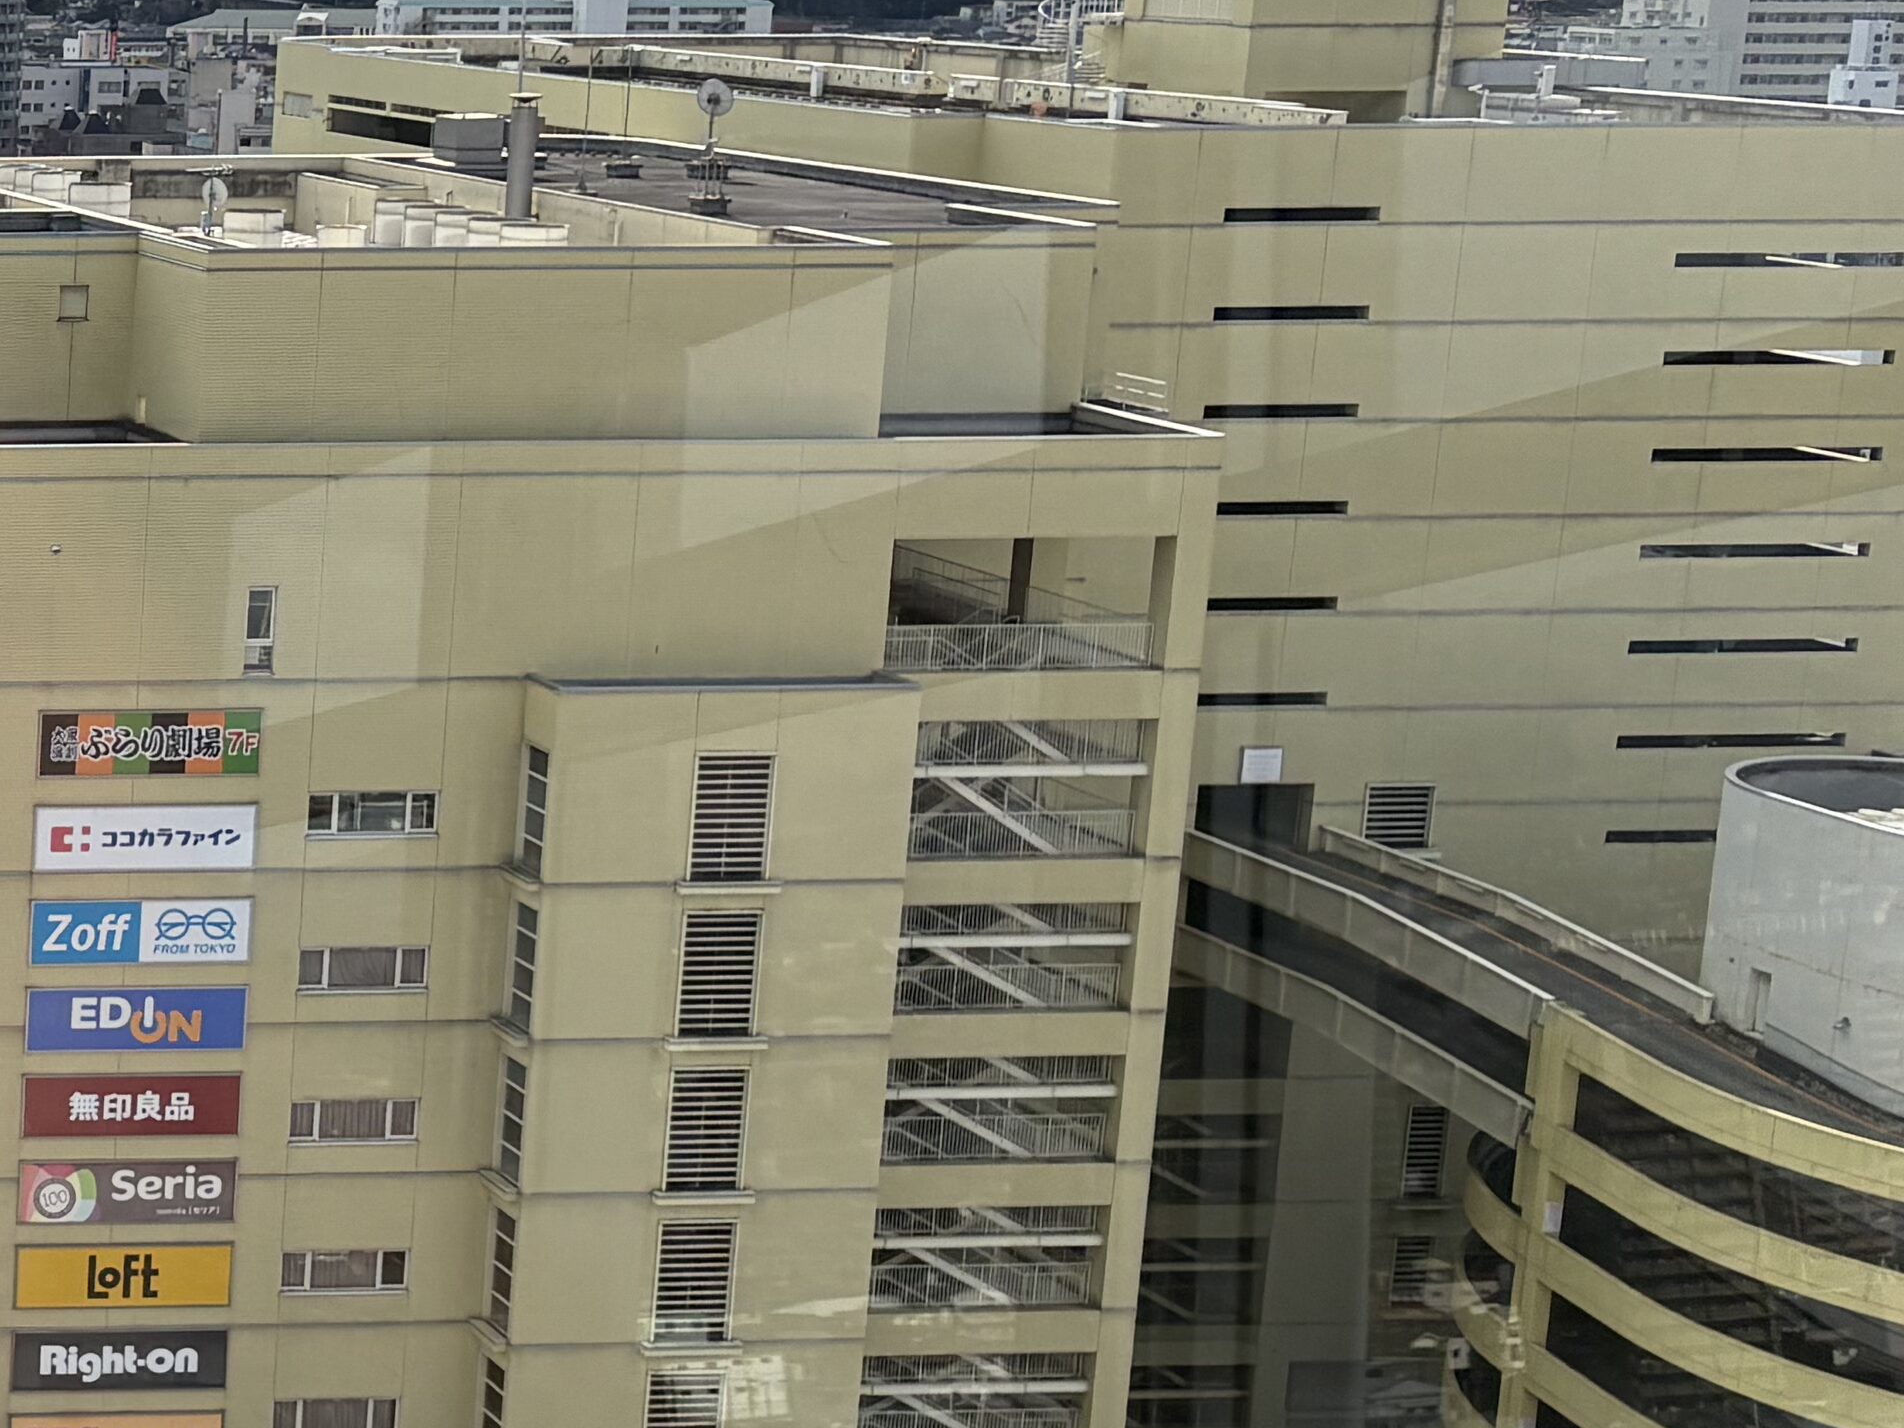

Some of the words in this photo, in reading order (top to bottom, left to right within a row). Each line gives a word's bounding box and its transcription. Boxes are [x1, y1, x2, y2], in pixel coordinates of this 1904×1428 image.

[80, 725, 222, 762] ぶらり劇場
[225, 729, 261, 756] 7F
[101, 827, 241, 848] ココカラファイン
[42, 912, 132, 952] Zoff
[152, 943, 190, 955] FROM
[192, 942, 237, 955] TOKYO
[70, 994, 203, 1044] EDION
[68, 1091, 195, 1122] 無印良品
[42, 1189, 69, 1208] 100
[111, 1165, 223, 1202] Seria
[39, 1345, 199, 1382] Right-on
